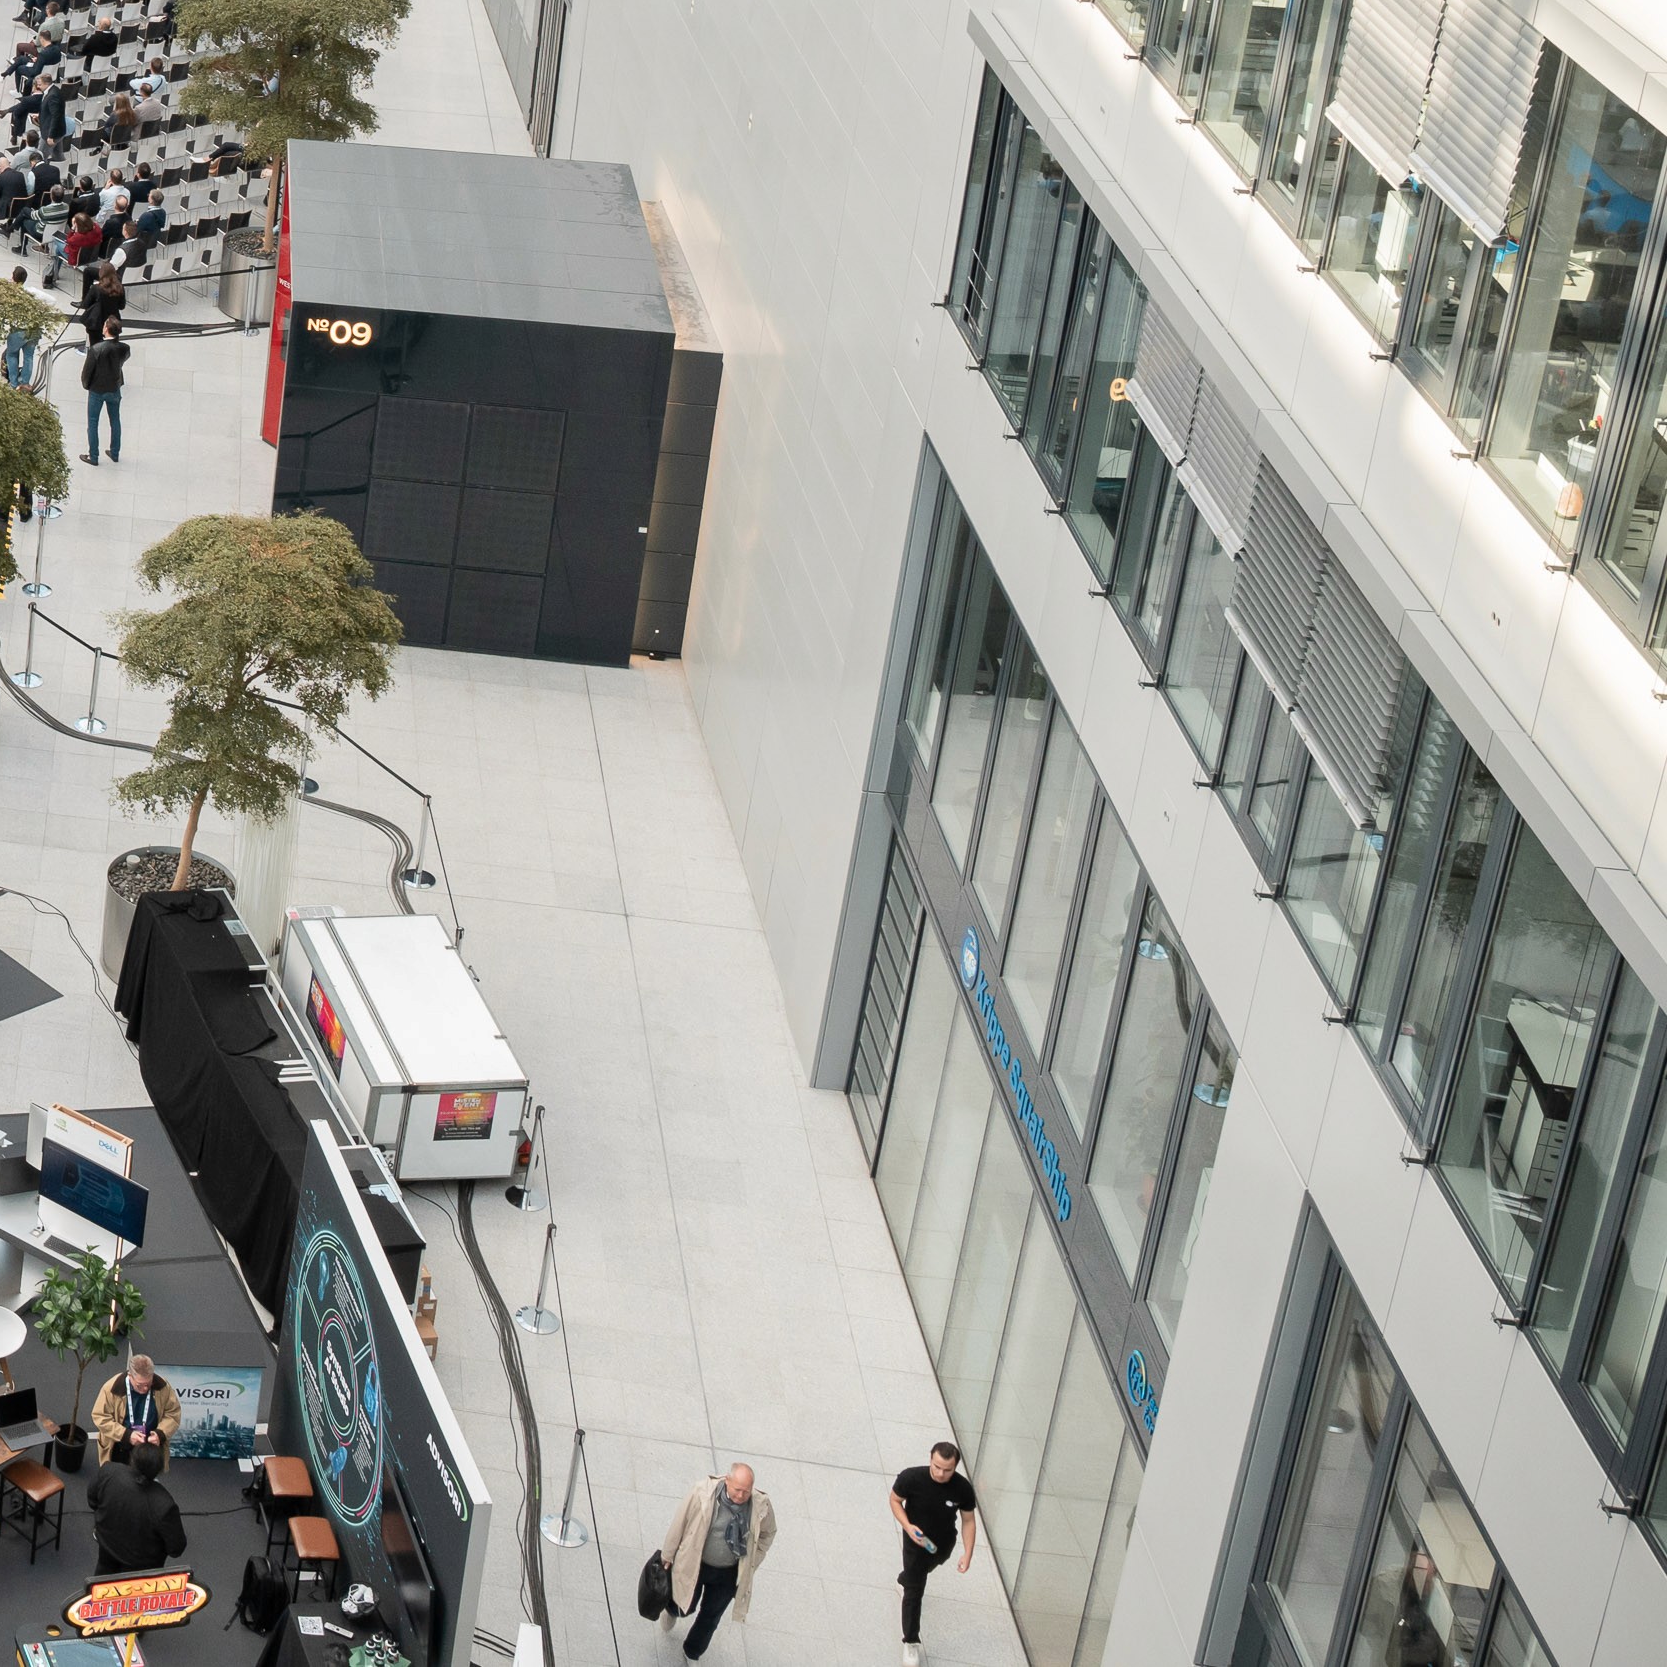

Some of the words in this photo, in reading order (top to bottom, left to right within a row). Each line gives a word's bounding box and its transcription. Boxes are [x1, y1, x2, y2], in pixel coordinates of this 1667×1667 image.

[975, 970, 1012, 1070] Krippe
[1009, 1058, 1072, 1222] SquairShip
[98, 1139, 119, 1154] DELL
[176, 1388, 230, 1399] VISORI
[426, 1433, 462, 1517] ADVISORI
[95, 1576, 184, 1600] PAC-MAN
[79, 1597, 139, 1620] BATTLE
[139, 1591, 196, 1612] ROYALE
